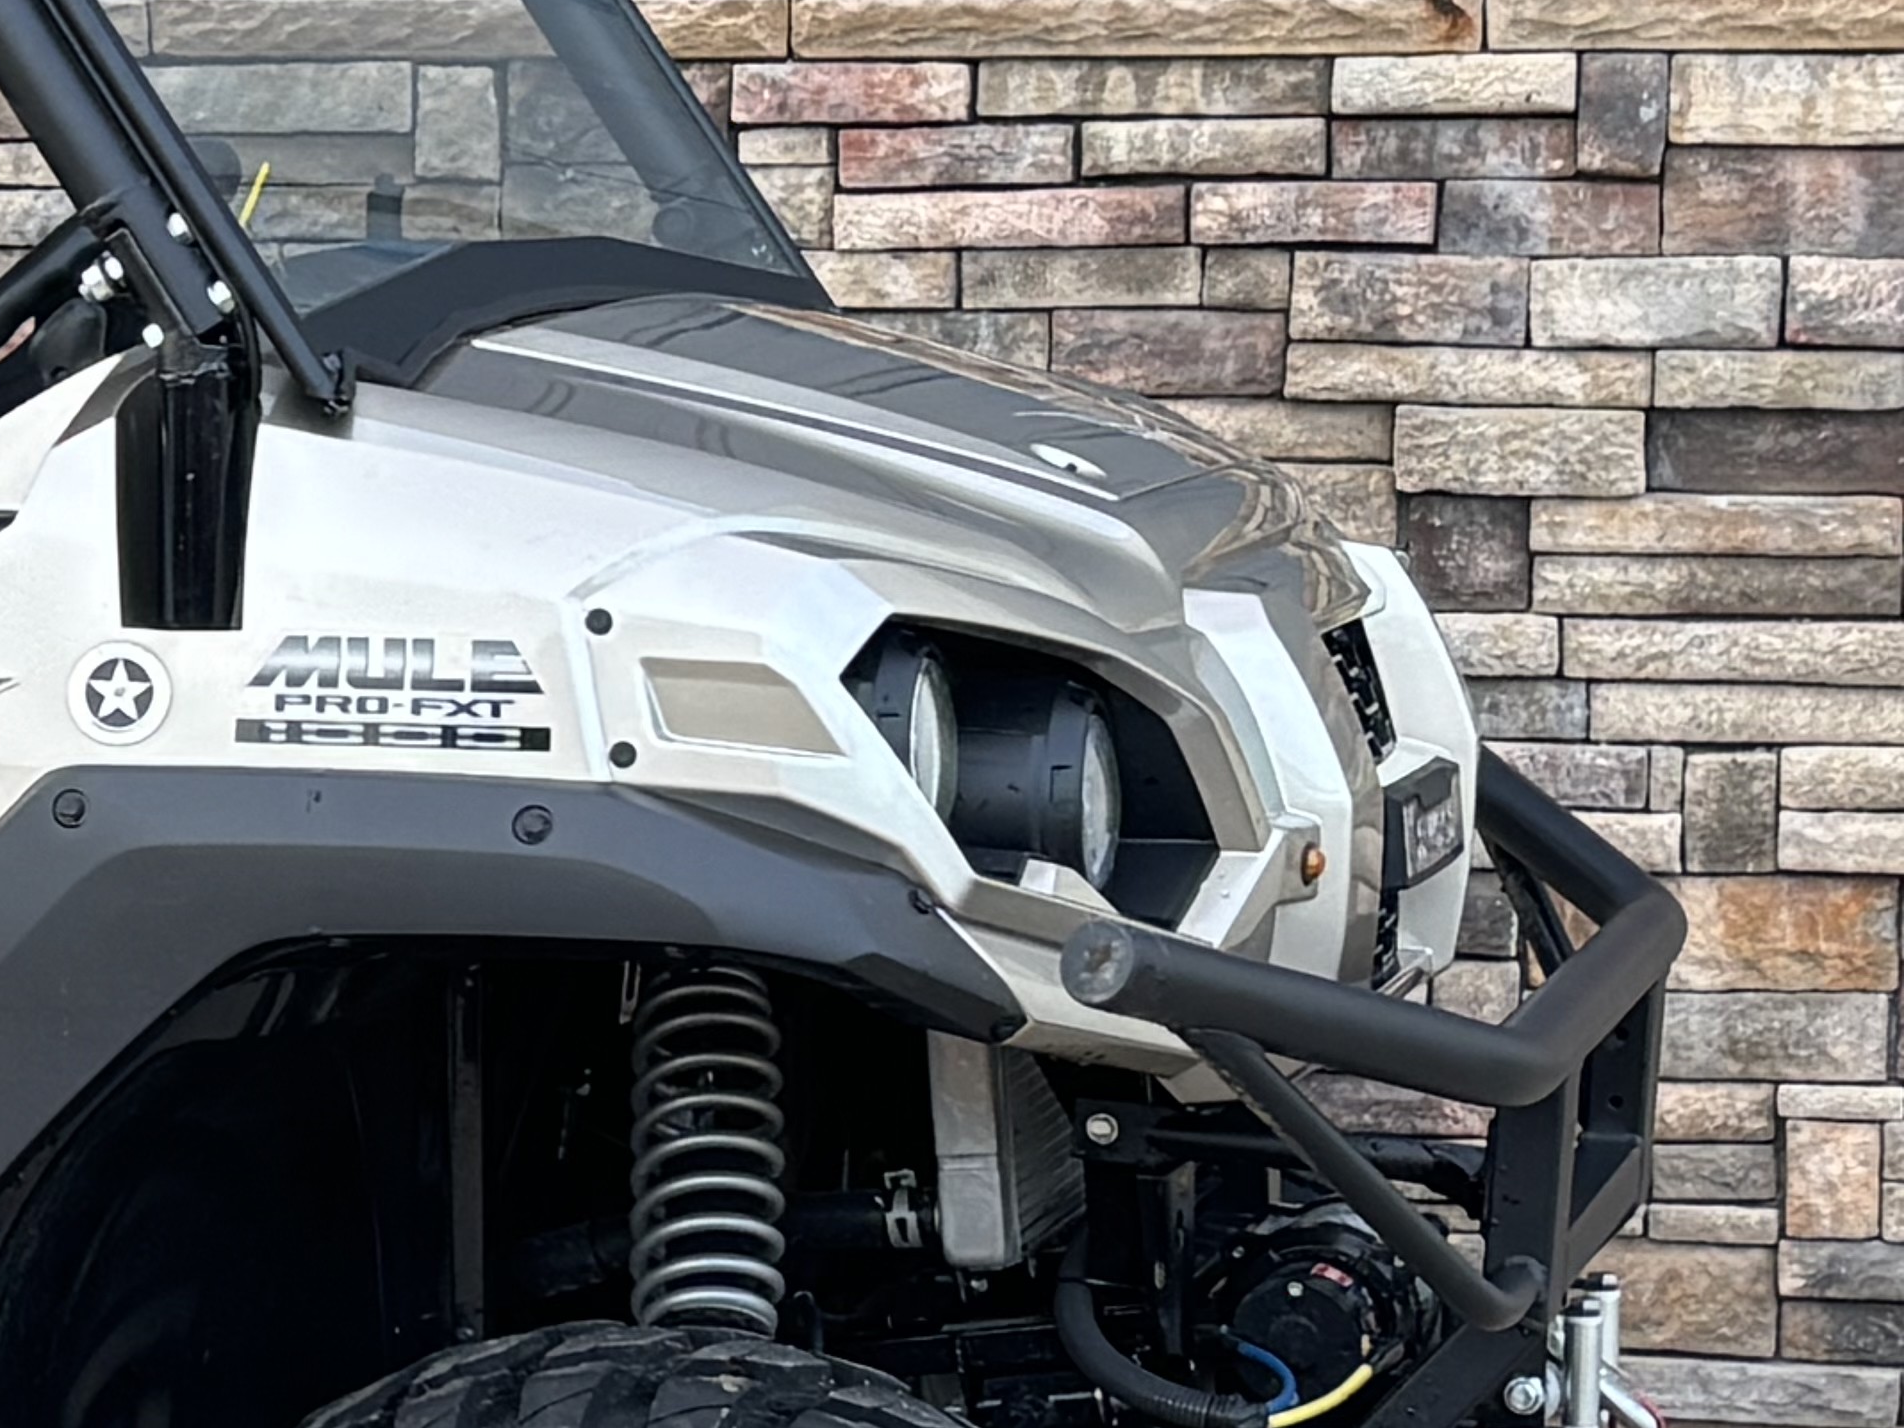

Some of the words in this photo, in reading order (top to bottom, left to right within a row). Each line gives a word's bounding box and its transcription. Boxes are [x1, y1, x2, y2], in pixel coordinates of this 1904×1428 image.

[248, 635, 545, 694] MULE
[274, 693, 516, 719] PRO-FXT
[264, 721, 522, 750] 1000
